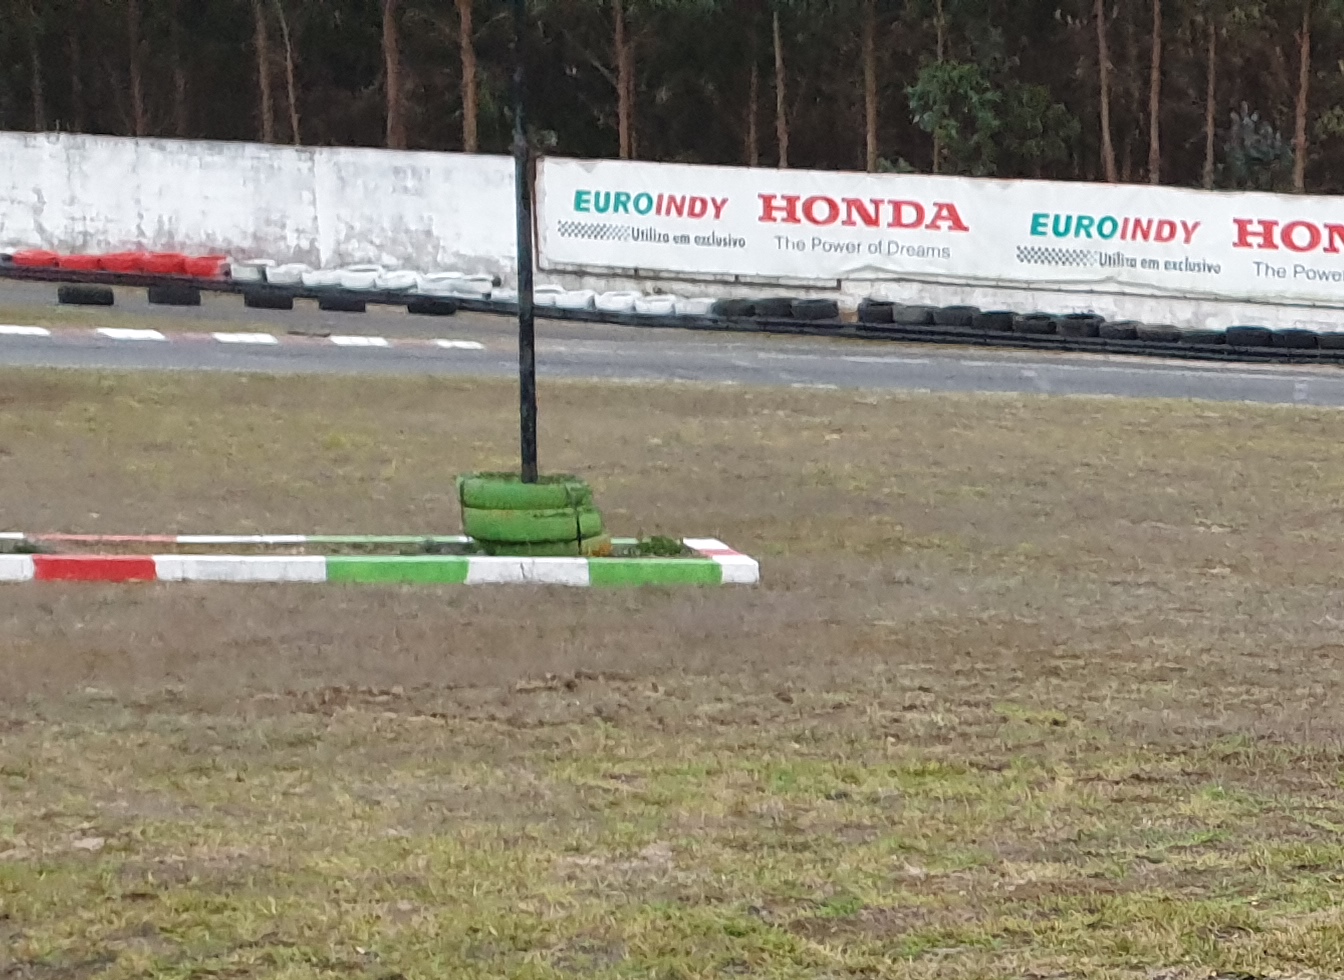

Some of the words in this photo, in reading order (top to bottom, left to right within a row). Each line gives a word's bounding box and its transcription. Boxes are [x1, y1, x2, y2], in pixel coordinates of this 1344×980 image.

[573, 190, 729, 220] EUROINDY
[757, 192, 970, 232] HONDA
[673, 234, 691, 246] em
[1029, 212, 1201, 245] EUROINDY
[774, 235, 806, 252] The
[811, 237, 862, 256] Power
[867, 239, 883, 256] of
[887, 240, 951, 260] Dreams
[1253, 261, 1287, 279] The
